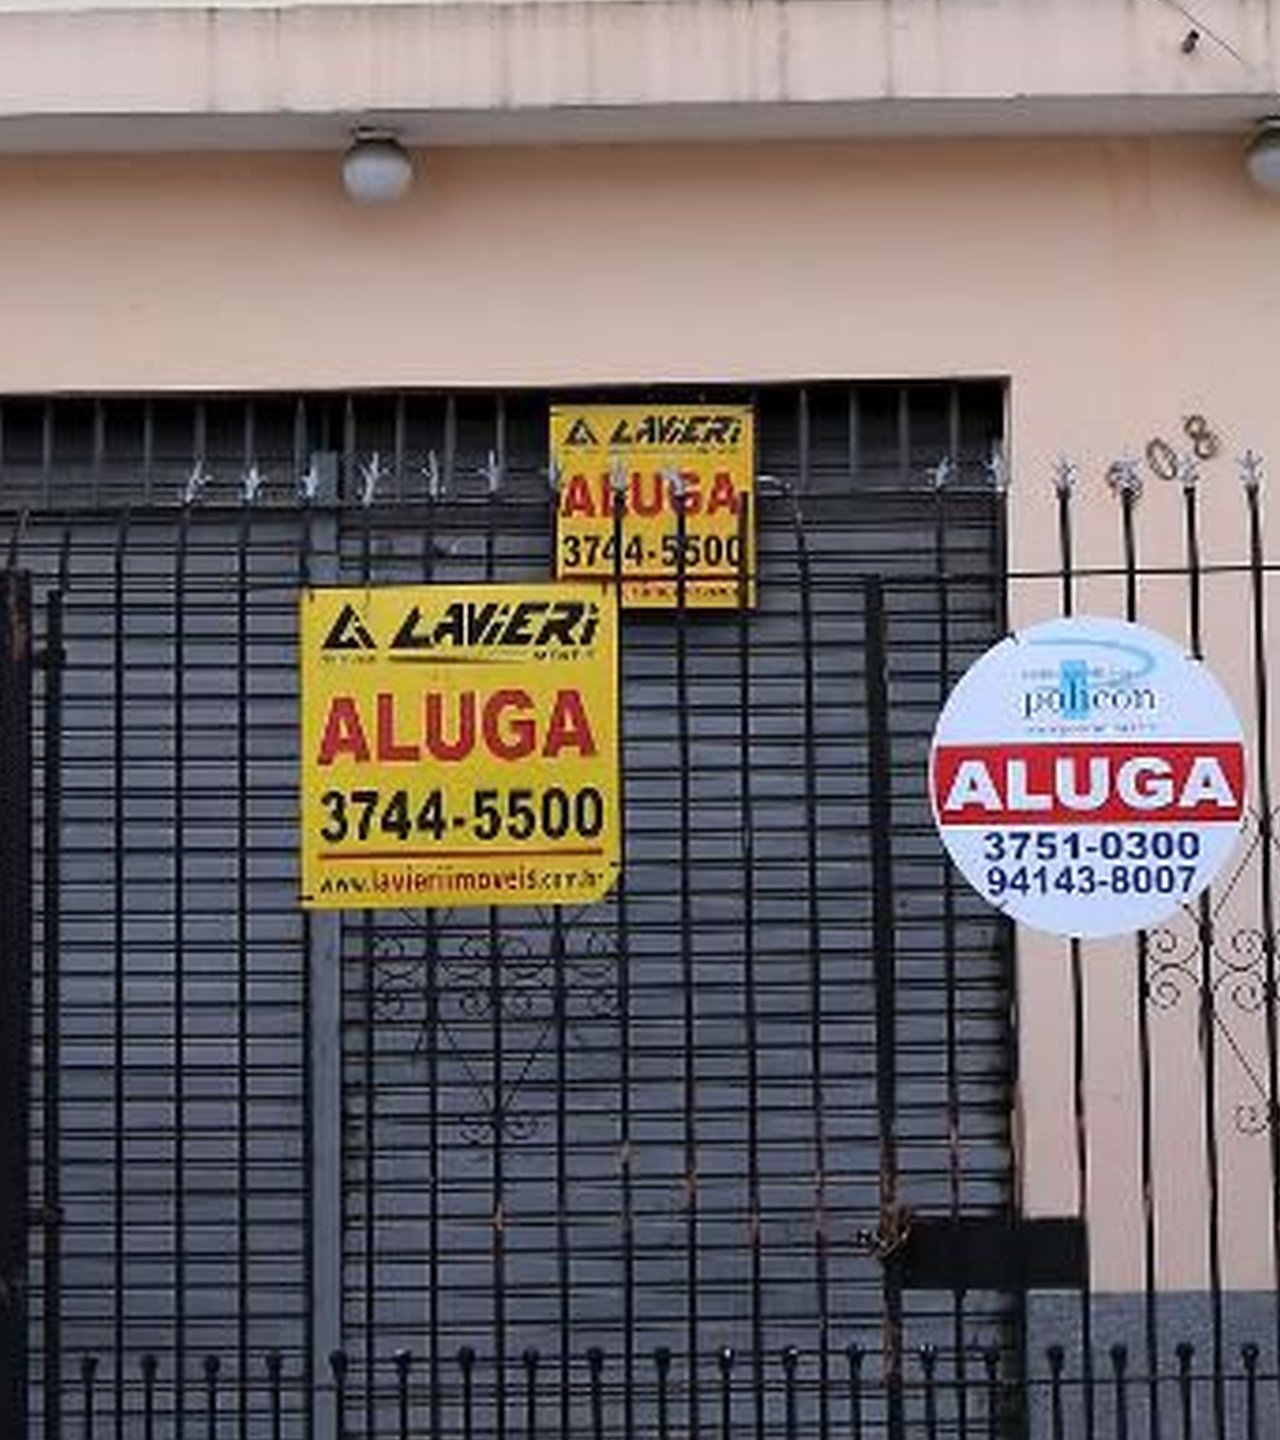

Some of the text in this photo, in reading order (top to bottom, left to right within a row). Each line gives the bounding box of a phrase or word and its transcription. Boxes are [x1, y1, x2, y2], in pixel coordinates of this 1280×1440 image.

[561, 470, 739, 518] ALUGA
[318, 688, 597, 766] ALUGA
[943, 756, 1238, 812] ALUGA
[320, 786, 604, 844] 3744-5500
[983, 830, 1201, 862] 3751-0300
[985, 864, 1197, 896] 94143-8007
